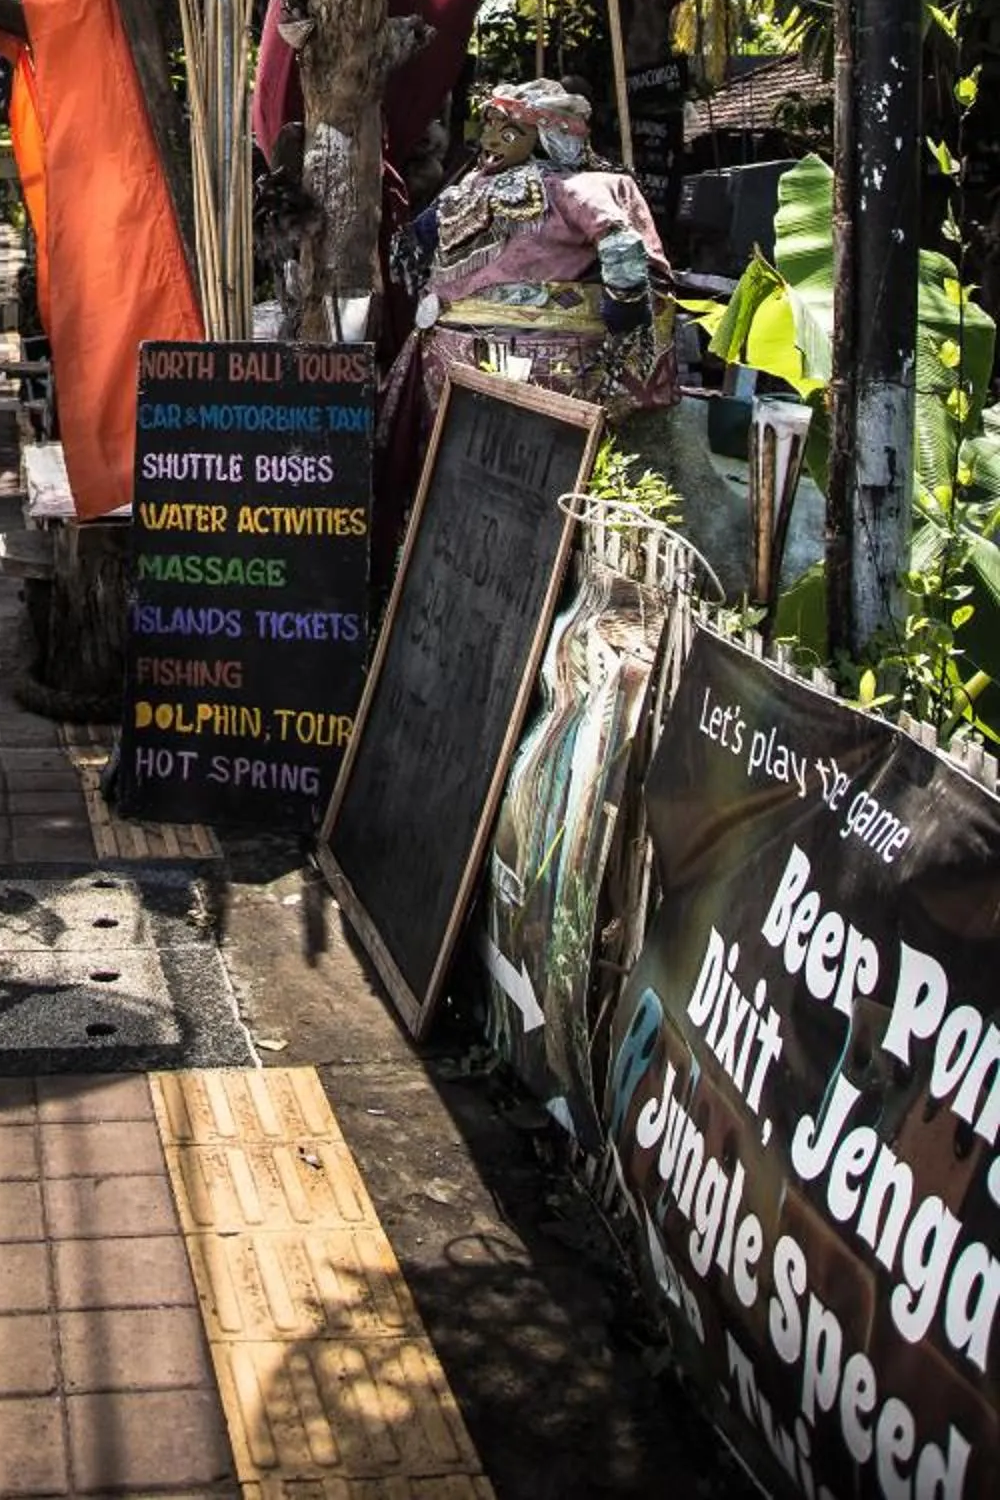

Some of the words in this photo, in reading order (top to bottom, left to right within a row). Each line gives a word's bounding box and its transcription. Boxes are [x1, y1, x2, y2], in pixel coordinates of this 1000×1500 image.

[142, 352, 214, 382] NORTH
[228, 352, 281, 382] BALI
[296, 352, 367, 383] TOURS
[200, 405, 322, 431] MOTORBIKE
[142, 453, 243, 482] SHUTTLE
[255, 454, 334, 486] BUSES
[139, 503, 227, 533] WATER
[237, 506, 368, 536] ACTIVITIES
[137, 552, 287, 587] MASSAGE
[133, 605, 243, 638] ISLANDS
[255, 611, 359, 642] TICKETS
[136, 657, 243, 689] FISHING
[135, 749, 199, 782] HOT
[206, 755, 321, 797] SPRING
[699, 687, 747, 755] Let's
[747, 726, 807, 798] play
[815, 757, 850, 812] the
[839, 790, 911, 863] game
[761, 842, 880, 1019] Beer
[881, 939, 1000, 1206] Pon
[687, 924, 783, 1147] Dixit,
[791, 1072, 1000, 1374] Jenga
[636, 1060, 764, 1308] Jungle
